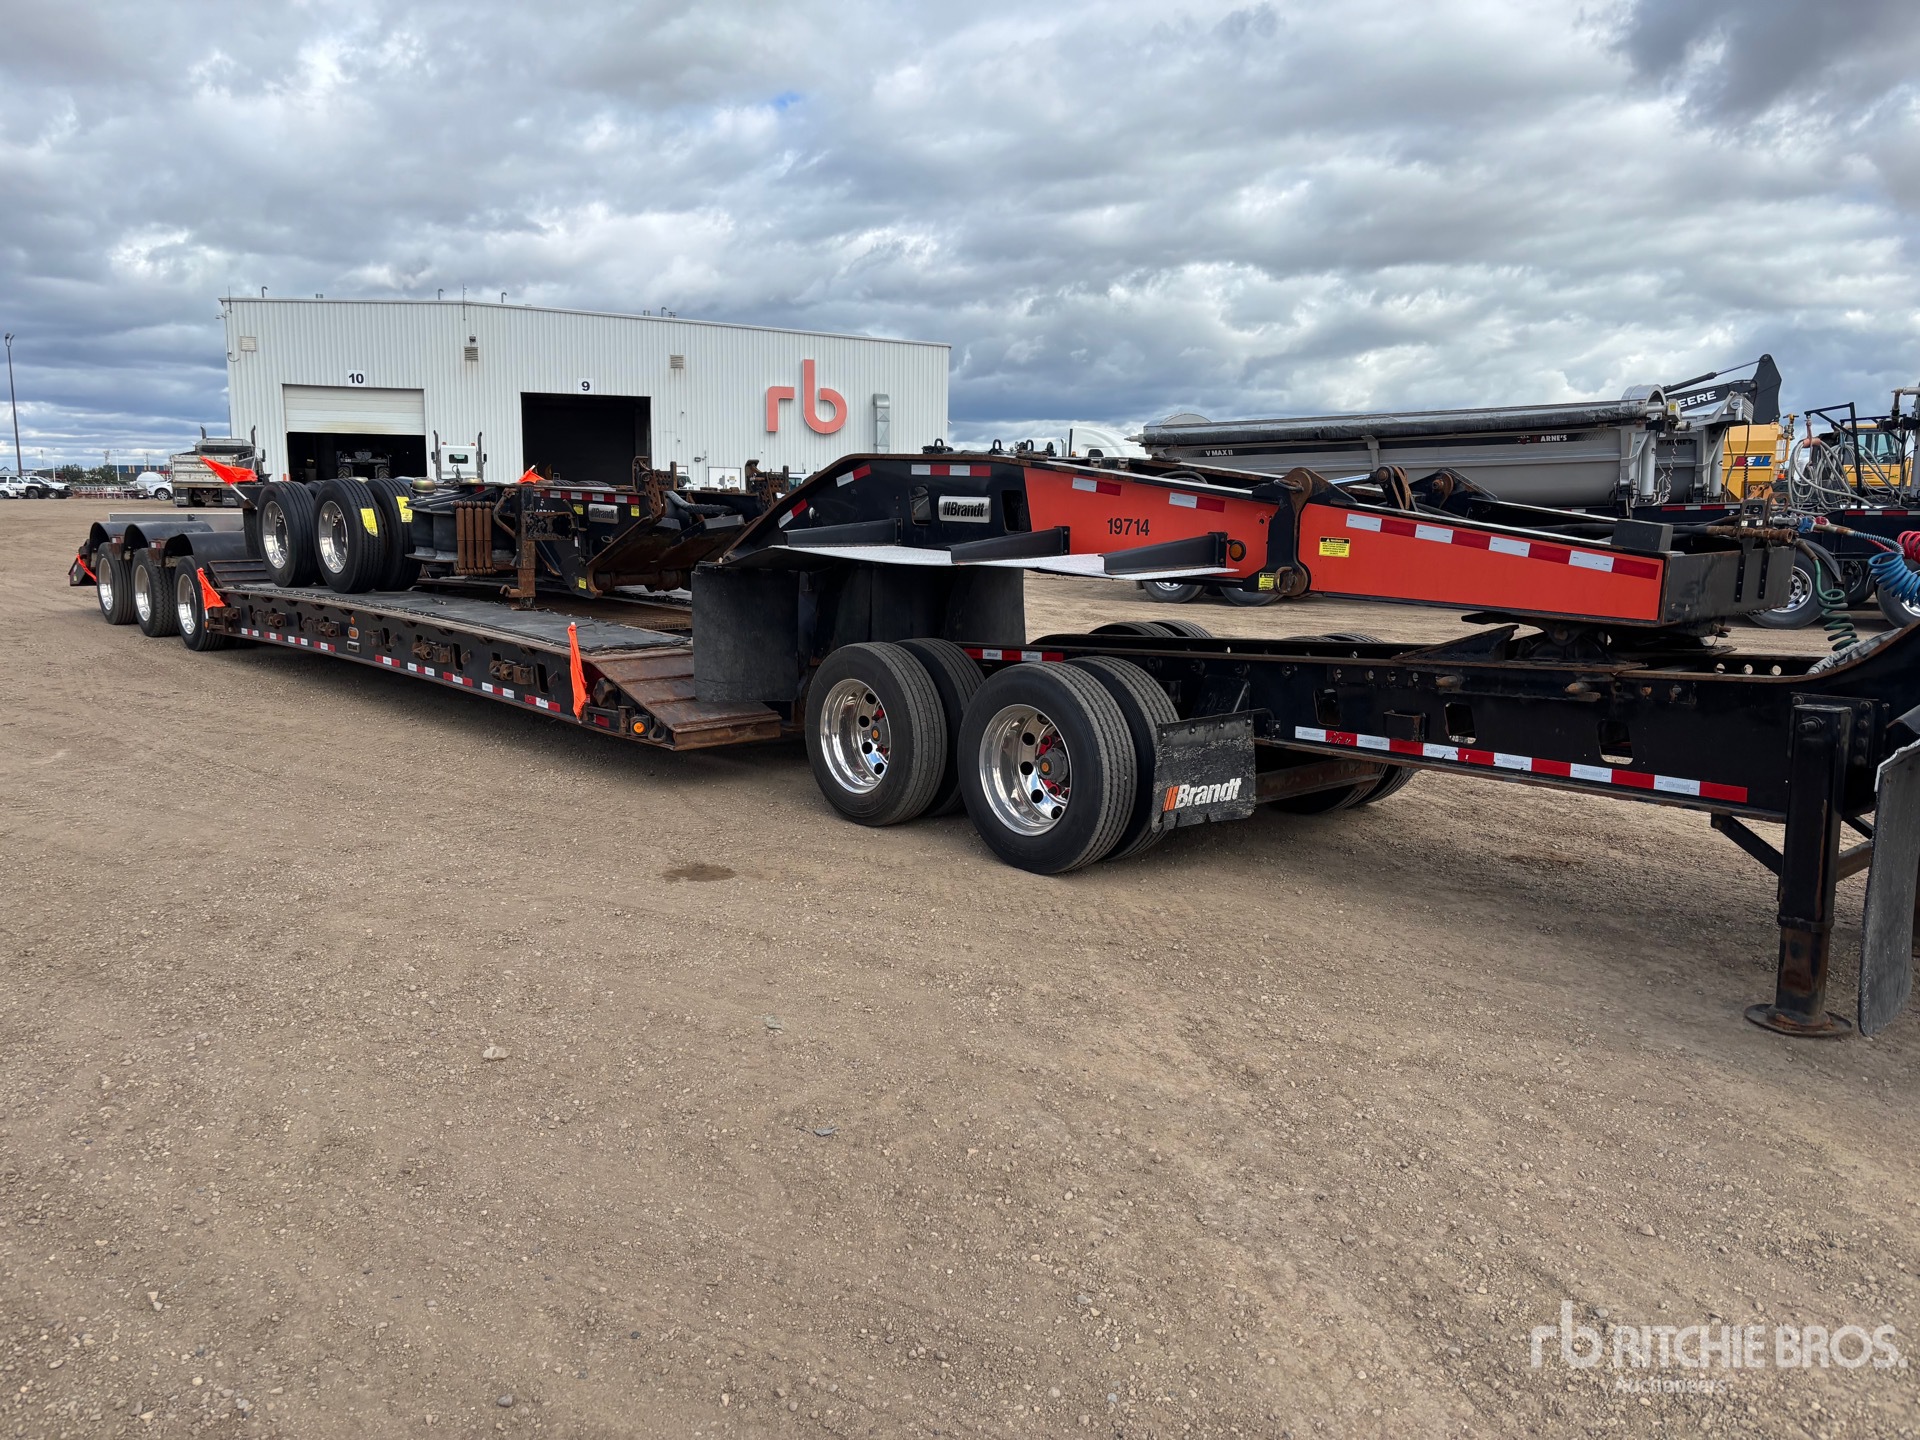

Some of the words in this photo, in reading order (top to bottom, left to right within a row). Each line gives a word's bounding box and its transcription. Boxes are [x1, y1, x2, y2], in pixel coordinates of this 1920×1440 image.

[348, 373, 364, 385] 10
[581, 381, 591, 392] 9
[766, 359, 848, 434] rb
[1677, 390, 1717, 408] EERE
[1540, 434, 1568, 442] ARNE'S
[948, 501, 985, 517] Brandt
[1107, 517, 1150, 536] 19714
[1174, 777, 1242, 809] Brandt
